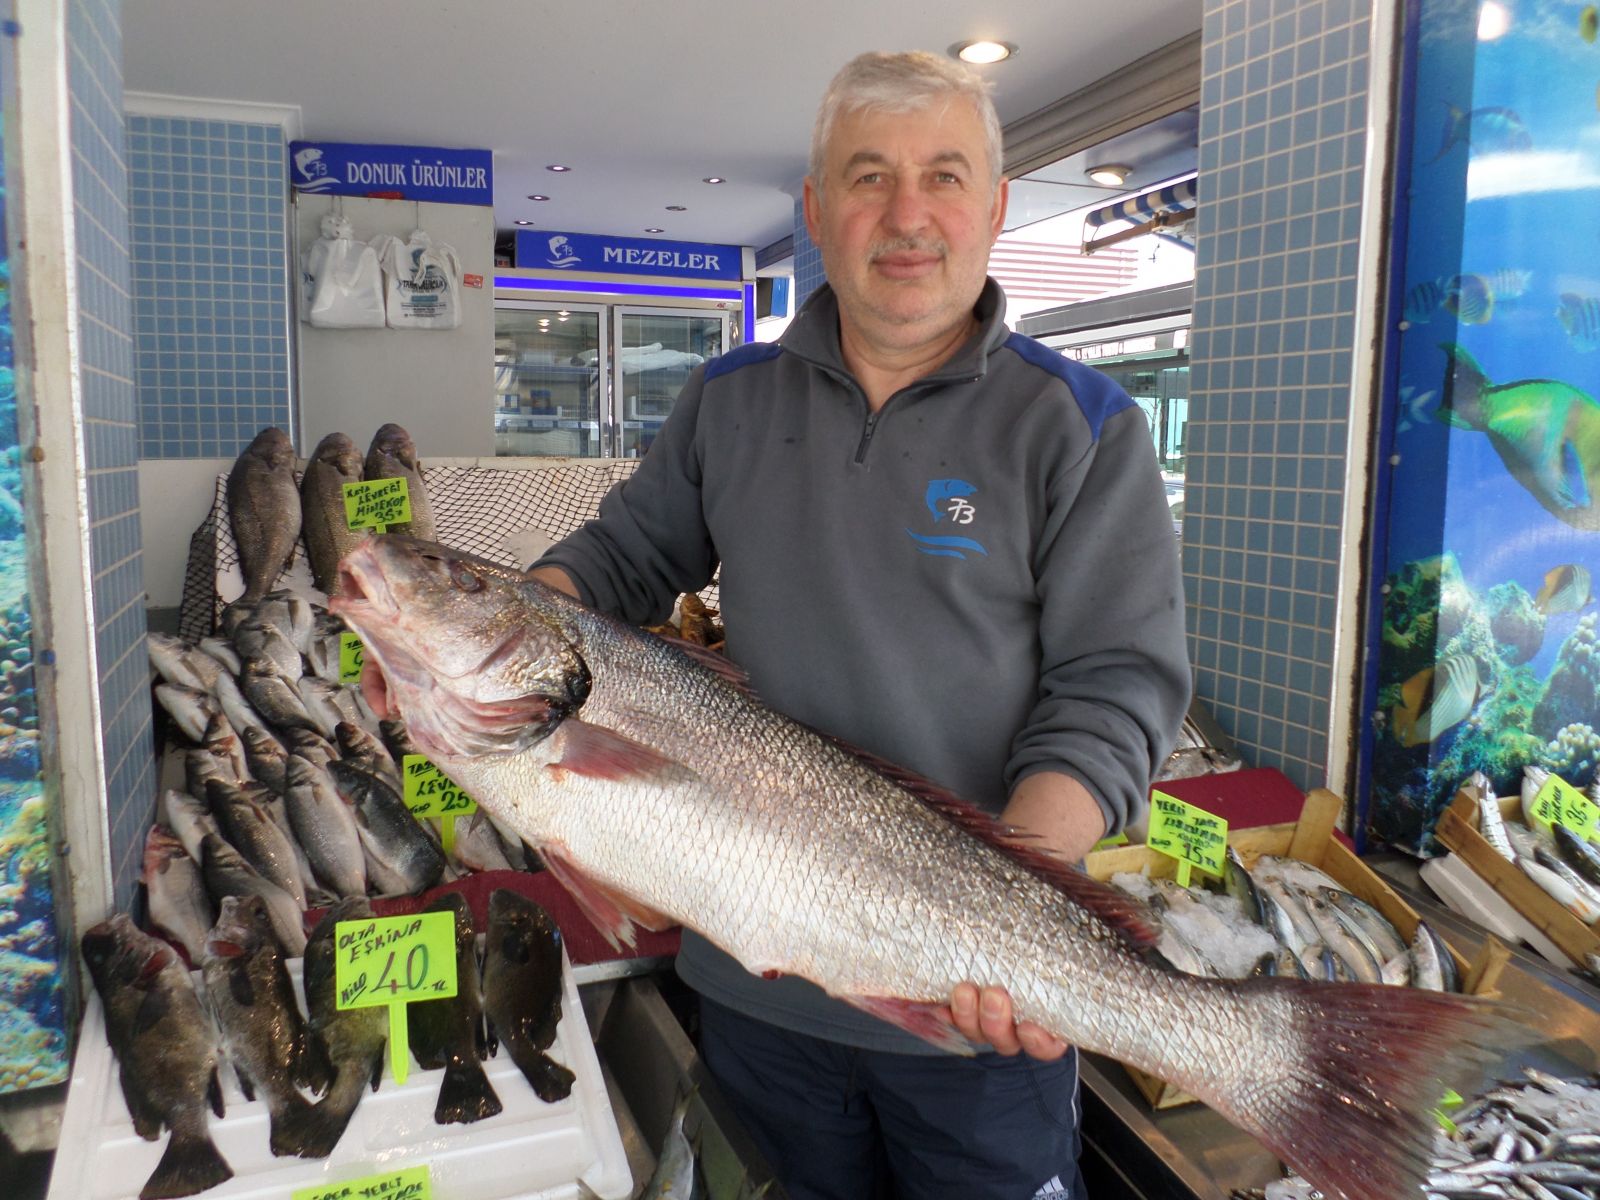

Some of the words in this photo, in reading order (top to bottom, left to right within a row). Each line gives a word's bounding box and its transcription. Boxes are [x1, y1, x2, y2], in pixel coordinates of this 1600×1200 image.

[347, 161, 407, 186] DONUK
[412, 159, 488, 189] ÜRÜNLER
[603, 247, 720, 270] MEZELER
[338, 922, 376, 949] OLTA
